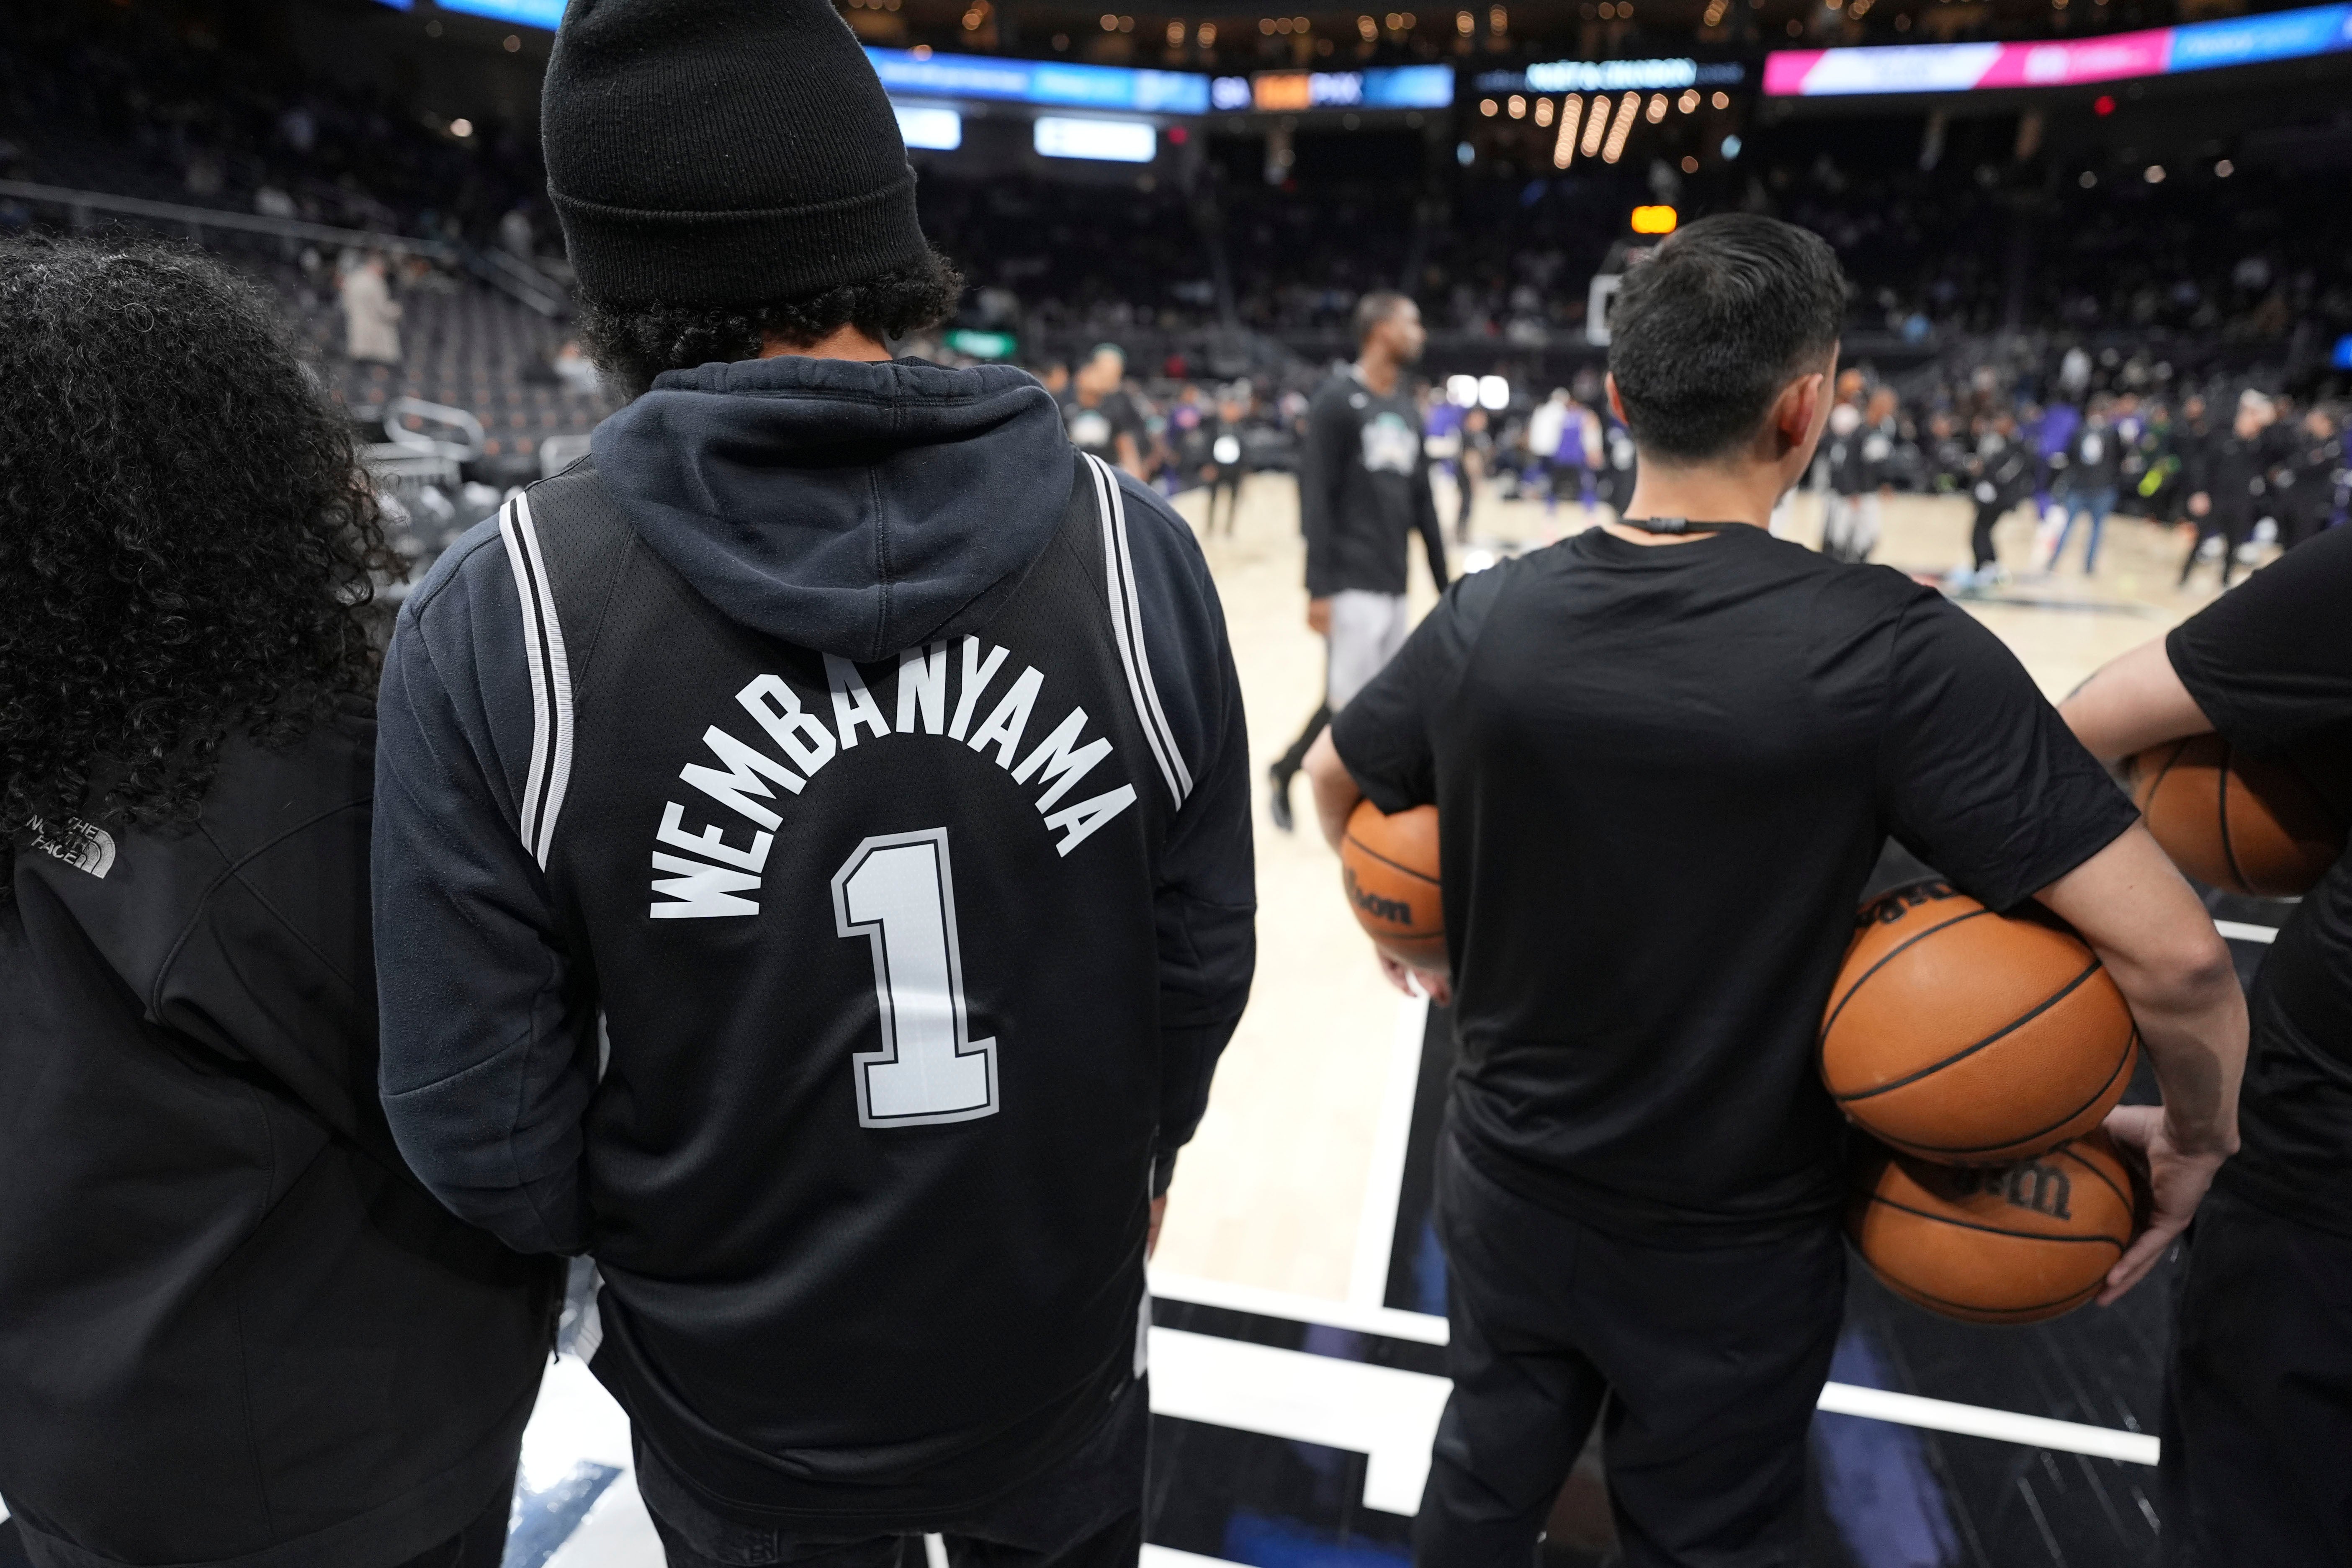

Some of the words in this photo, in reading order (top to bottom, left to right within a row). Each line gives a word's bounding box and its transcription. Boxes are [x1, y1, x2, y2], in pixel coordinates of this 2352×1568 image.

[31, 835, 78, 865] FACE
[650, 633, 1137, 918] WEMBANYAMA
[831, 826, 999, 1128] 1
